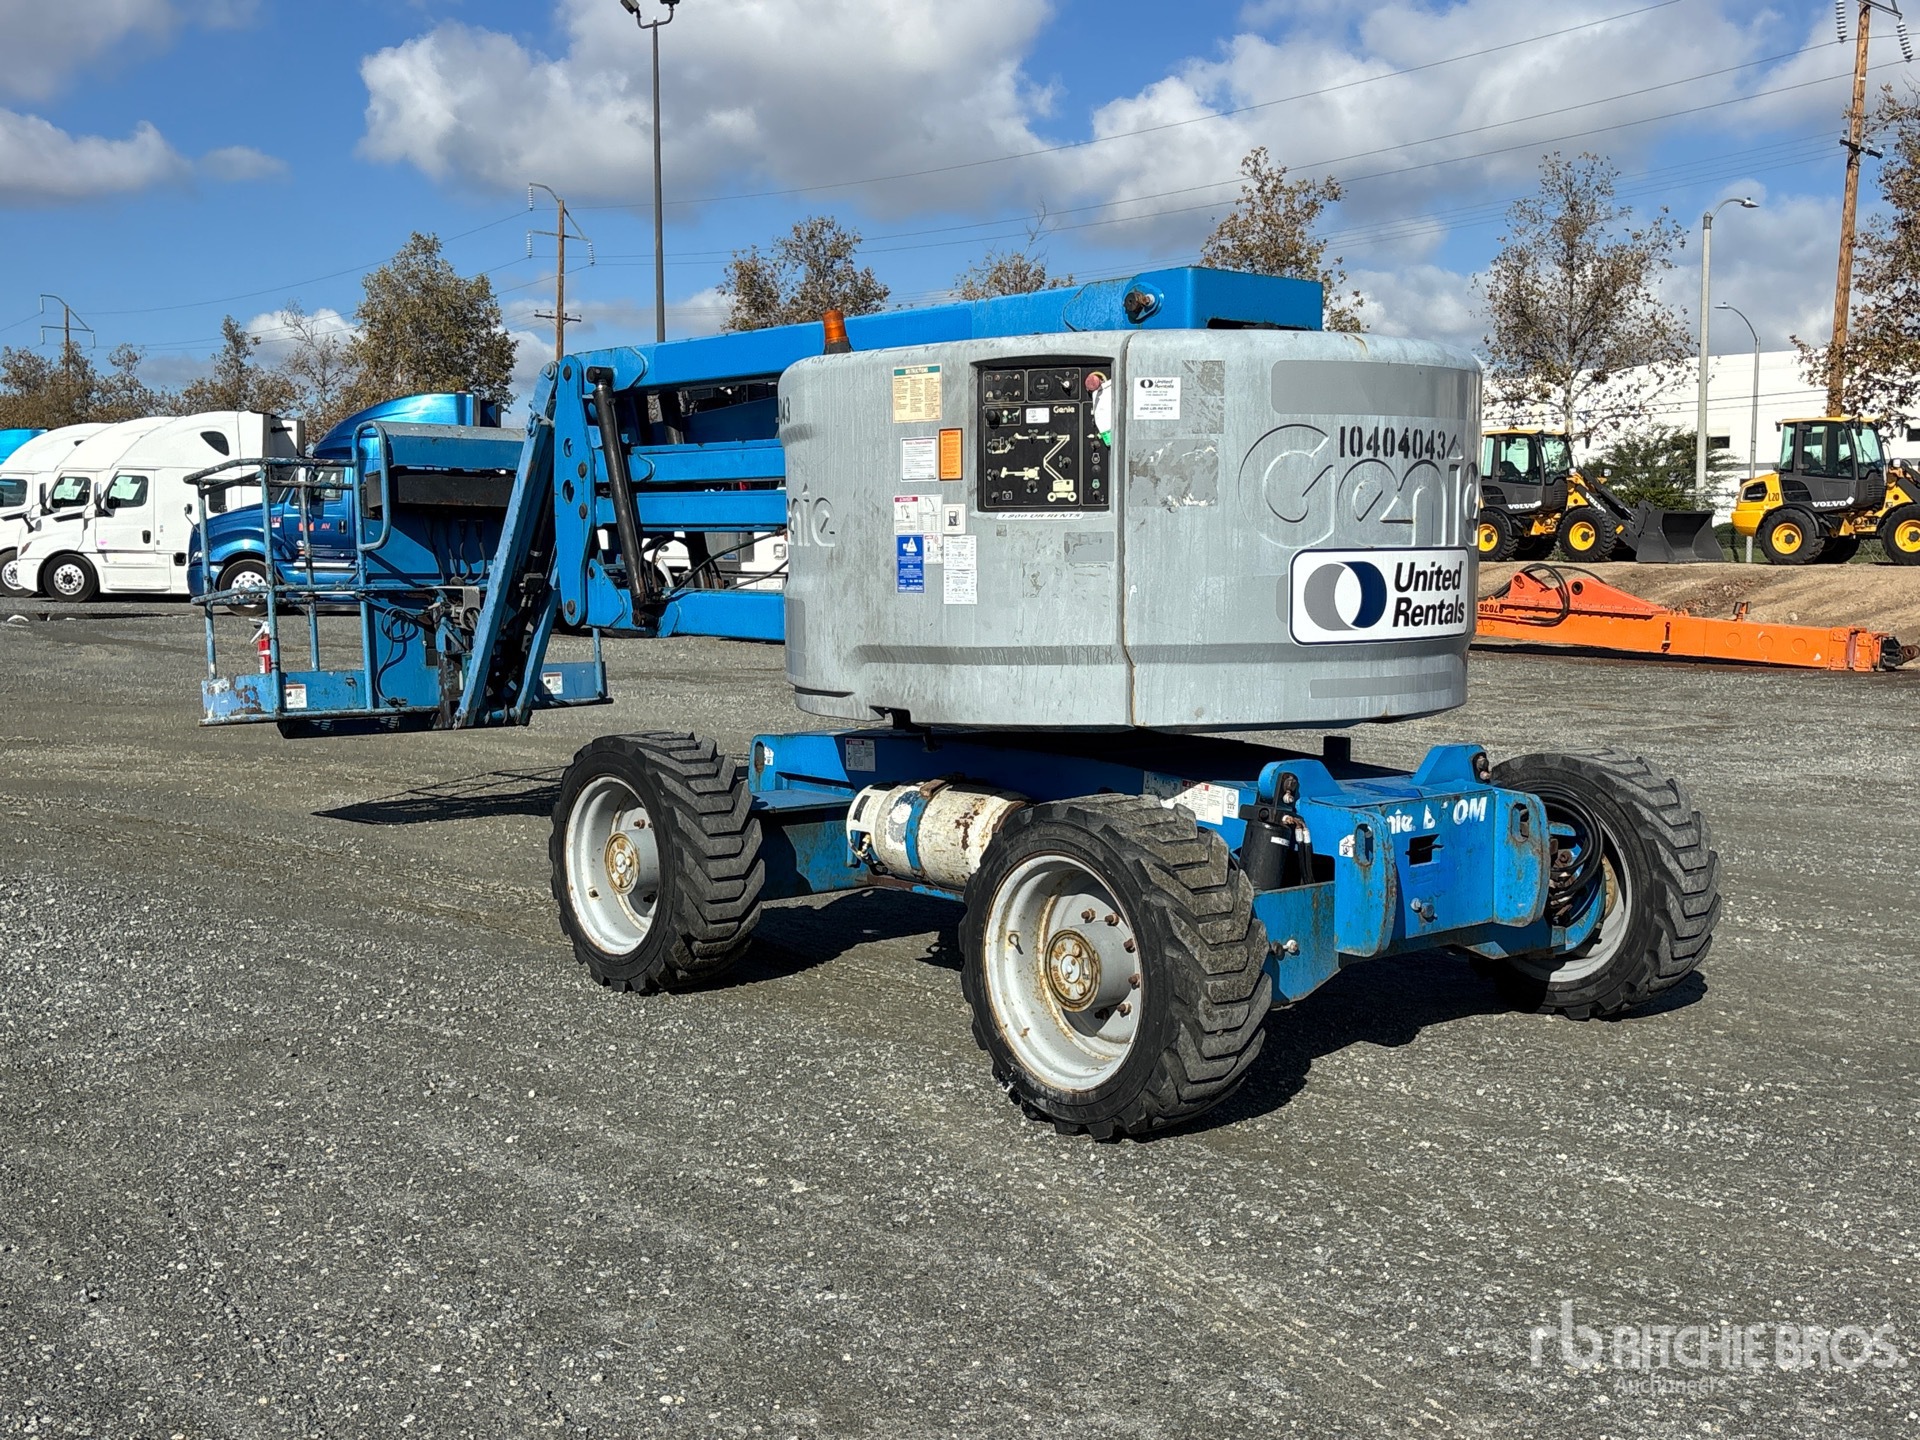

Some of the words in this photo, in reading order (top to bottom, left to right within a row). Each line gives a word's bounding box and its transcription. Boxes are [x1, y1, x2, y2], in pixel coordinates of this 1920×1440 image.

[1053, 405, 1075, 414] Genie
[1767, 492, 1780, 502] L20
[1507, 502, 1536, 510] VOLVO
[1811, 500, 1847, 508] VOLVO
[1393, 560, 1462, 593] United
[1392, 597, 1465, 628] Rentals
[1479, 603, 1504, 614] 97036
